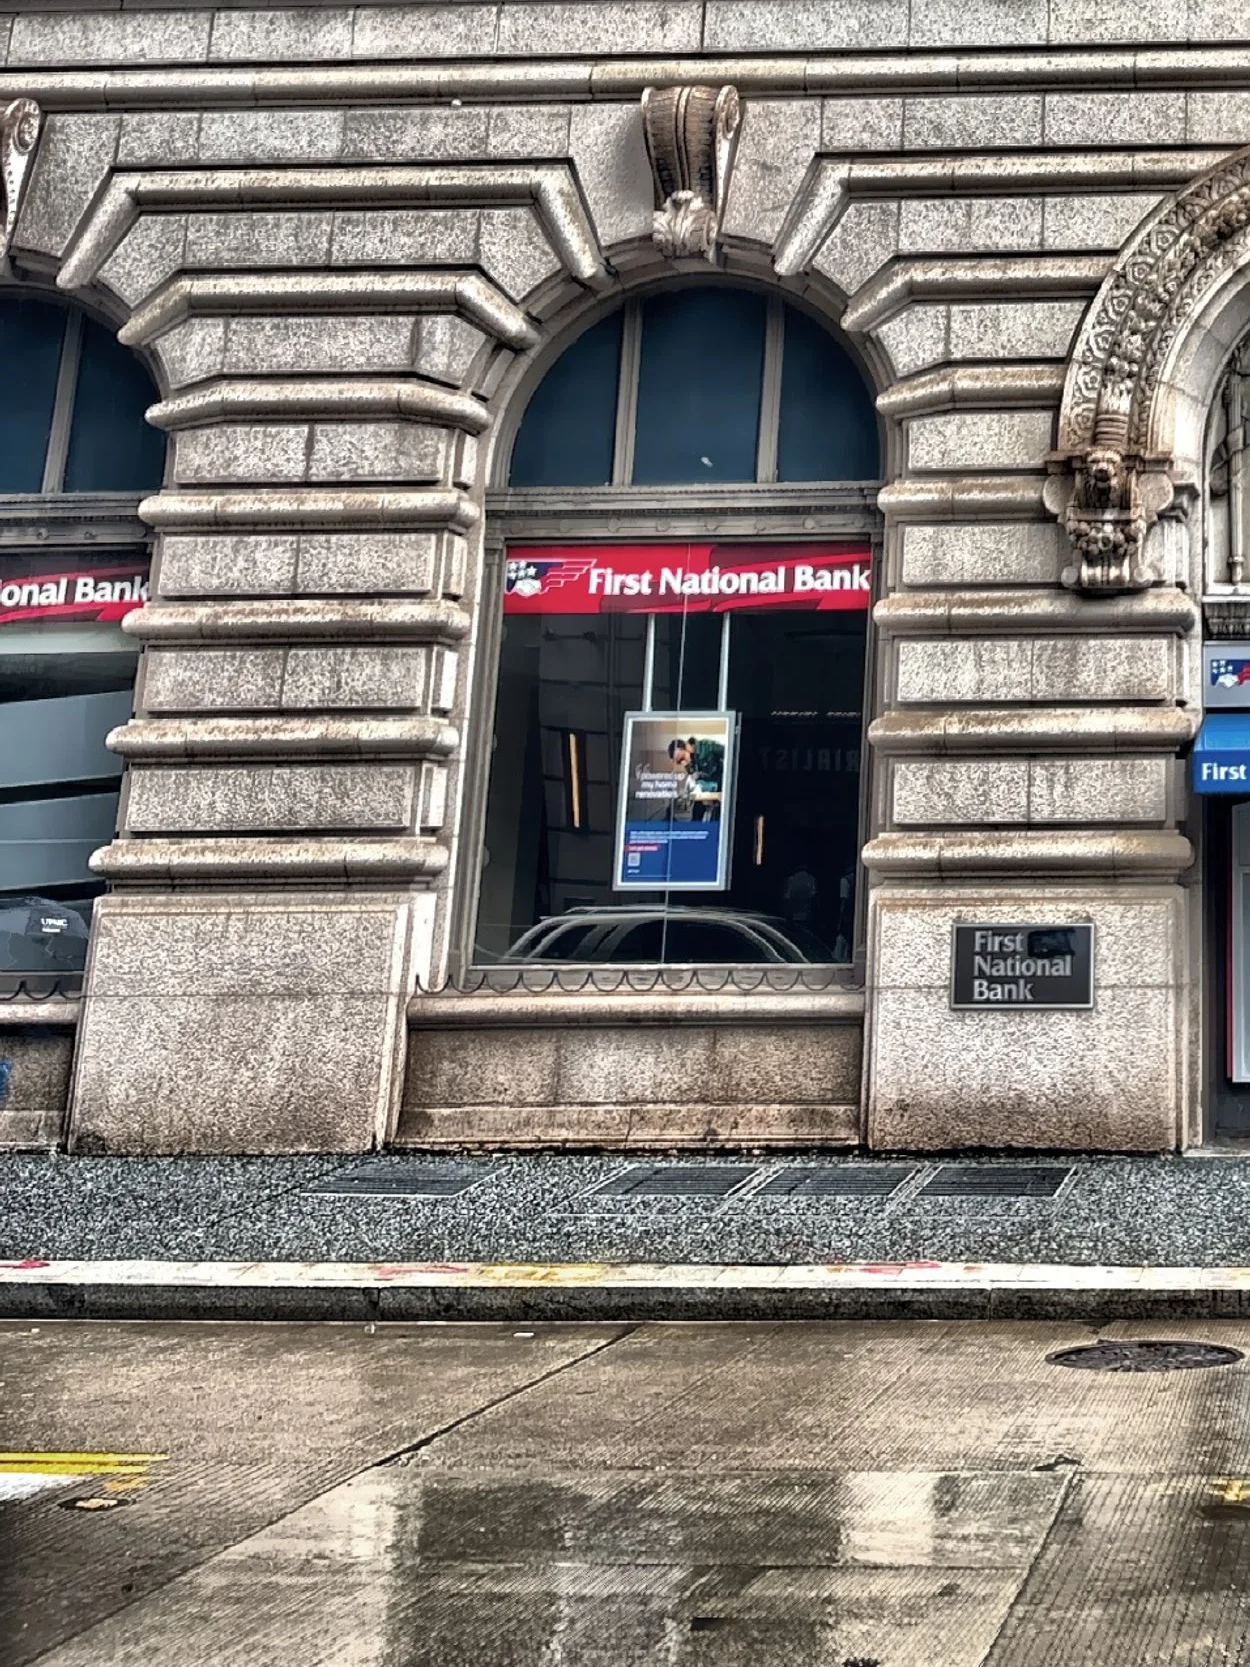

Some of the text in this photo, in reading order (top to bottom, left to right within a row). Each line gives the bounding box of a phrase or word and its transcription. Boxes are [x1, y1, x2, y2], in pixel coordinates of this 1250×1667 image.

[0, 575, 149, 607] onal Bank
[587, 564, 871, 596] First National Bank
[1201, 761, 1246, 781] First
[974, 930, 1024, 952] First
[973, 955, 1072, 977] National
[973, 978, 1034, 1000] Bank
